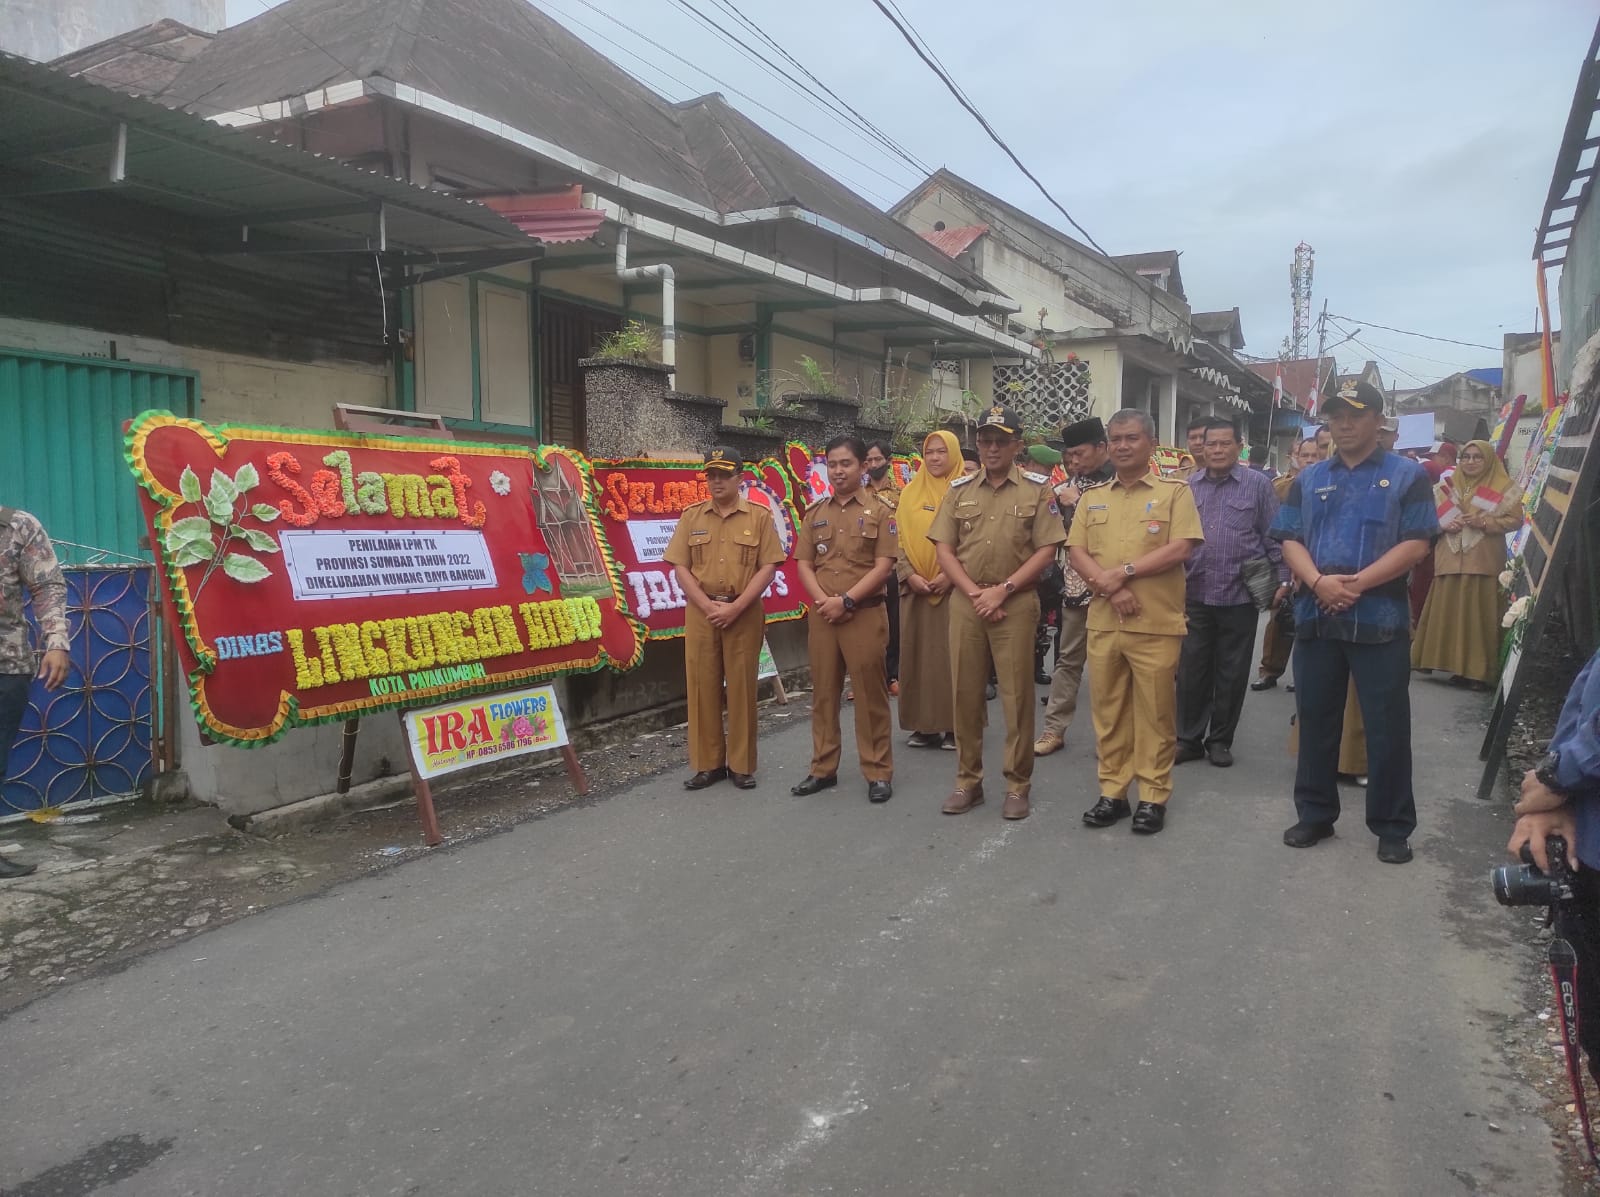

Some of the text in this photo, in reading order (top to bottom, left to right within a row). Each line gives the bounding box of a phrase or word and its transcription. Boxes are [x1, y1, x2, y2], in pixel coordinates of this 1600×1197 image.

[267, 450, 486, 527] Selamat
[316, 554, 471, 570] PROVINSI SUMBAR TAHUN 2022
[349, 538, 438, 552] PENILAIAN LPM TK
[305, 569, 486, 589] DIKELURAHAN NUNANG DAYA BANGUN
[214, 595, 602, 690] DINAS LINGKUNGAN HIDUP
[368, 662, 487, 697] KOTA PAYAKUMBUH
[422, 696, 547, 757] IRA FLOWERS
[478, 746, 498, 757] 0853
[517, 737, 533, 748] 1796
[1561, 981, 1574, 1017] EOS
